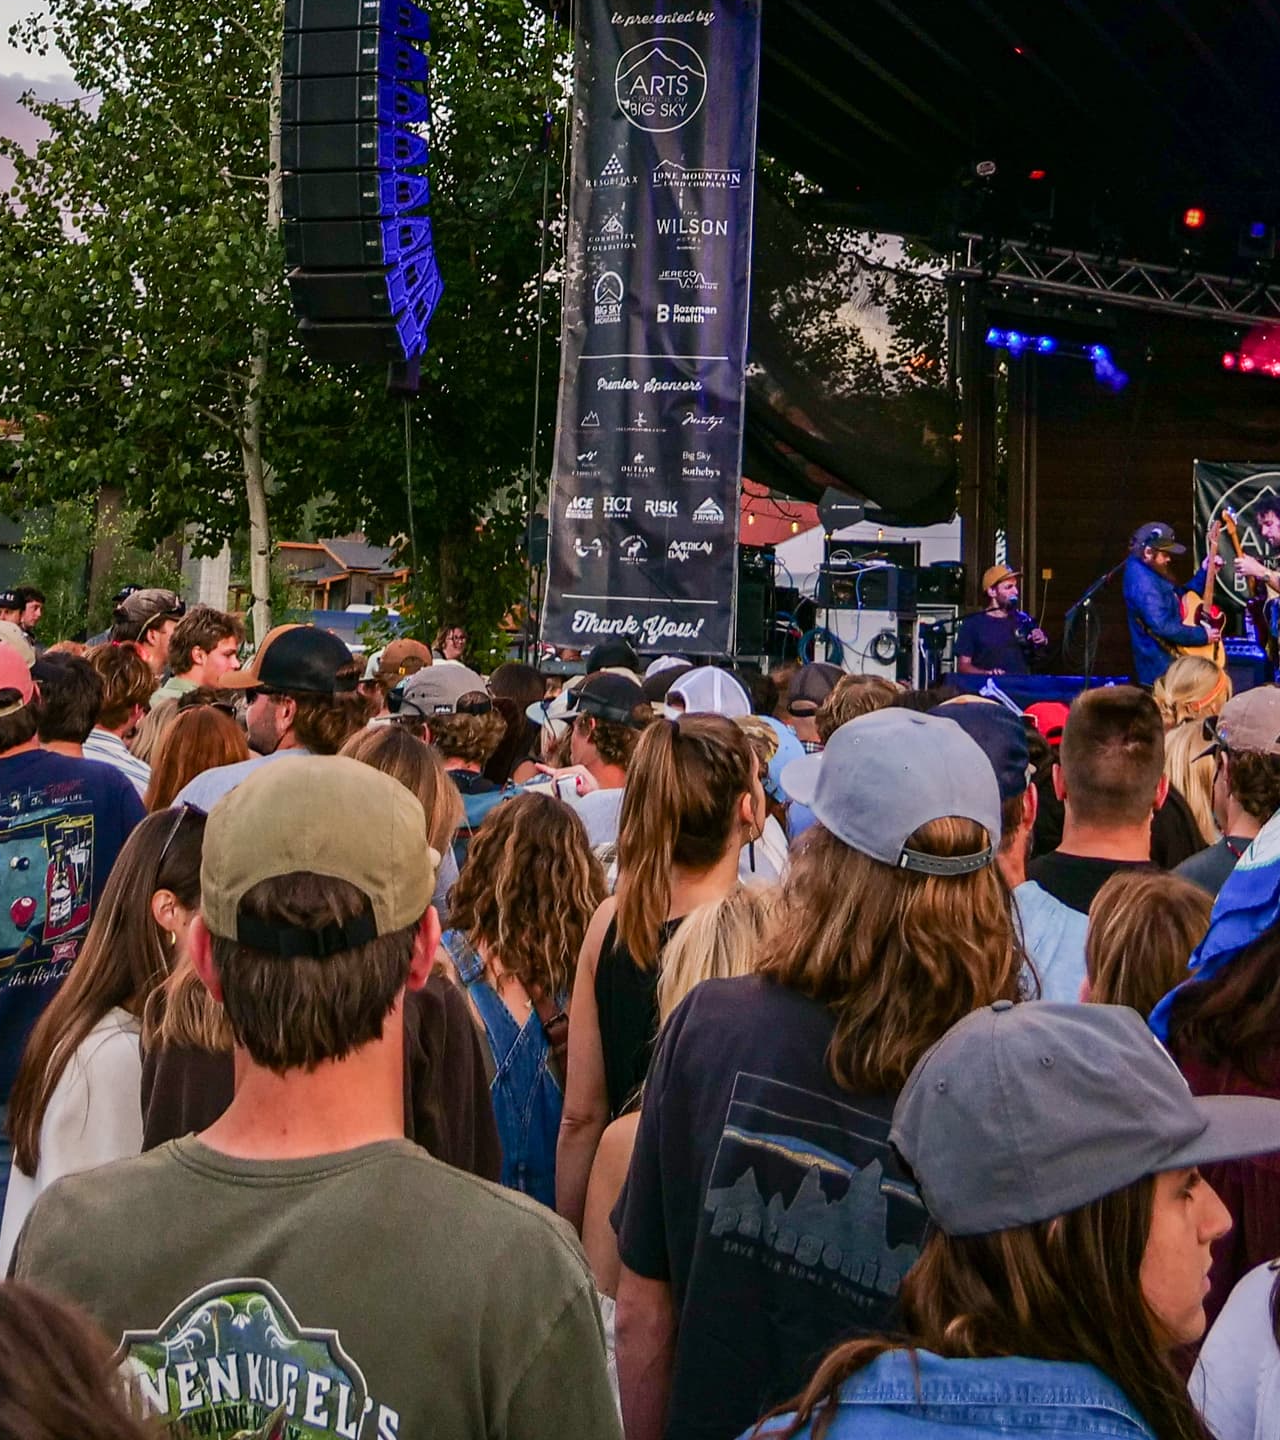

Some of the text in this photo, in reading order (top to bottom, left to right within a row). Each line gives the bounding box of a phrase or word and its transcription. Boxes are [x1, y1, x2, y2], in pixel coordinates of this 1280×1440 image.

[611, 10, 716, 27] is presented by
[630, 75, 688, 96] ARTS
[631, 102, 688, 117] BIG SKY
[653, 171, 741, 185] LONE MOUNTAIN
[689, 181, 726, 189] COMPANY
[657, 219, 728, 236] WILSON
[595, 304, 622, 316] BIG SKY
[673, 304, 717, 315] Bozeman
[673, 313, 704, 324] Health
[683, 451, 711, 461] Big Sky
[682, 466, 720, 478] Sotheby's
[567, 496, 594, 509] ACE
[603, 497, 632, 512] HCI
[645, 500, 678, 517] RISK
[572, 610, 705, 645] Thank You!
[710, 1206, 901, 1299] patagonia
[723, 1239, 754, 1259] SAVE
